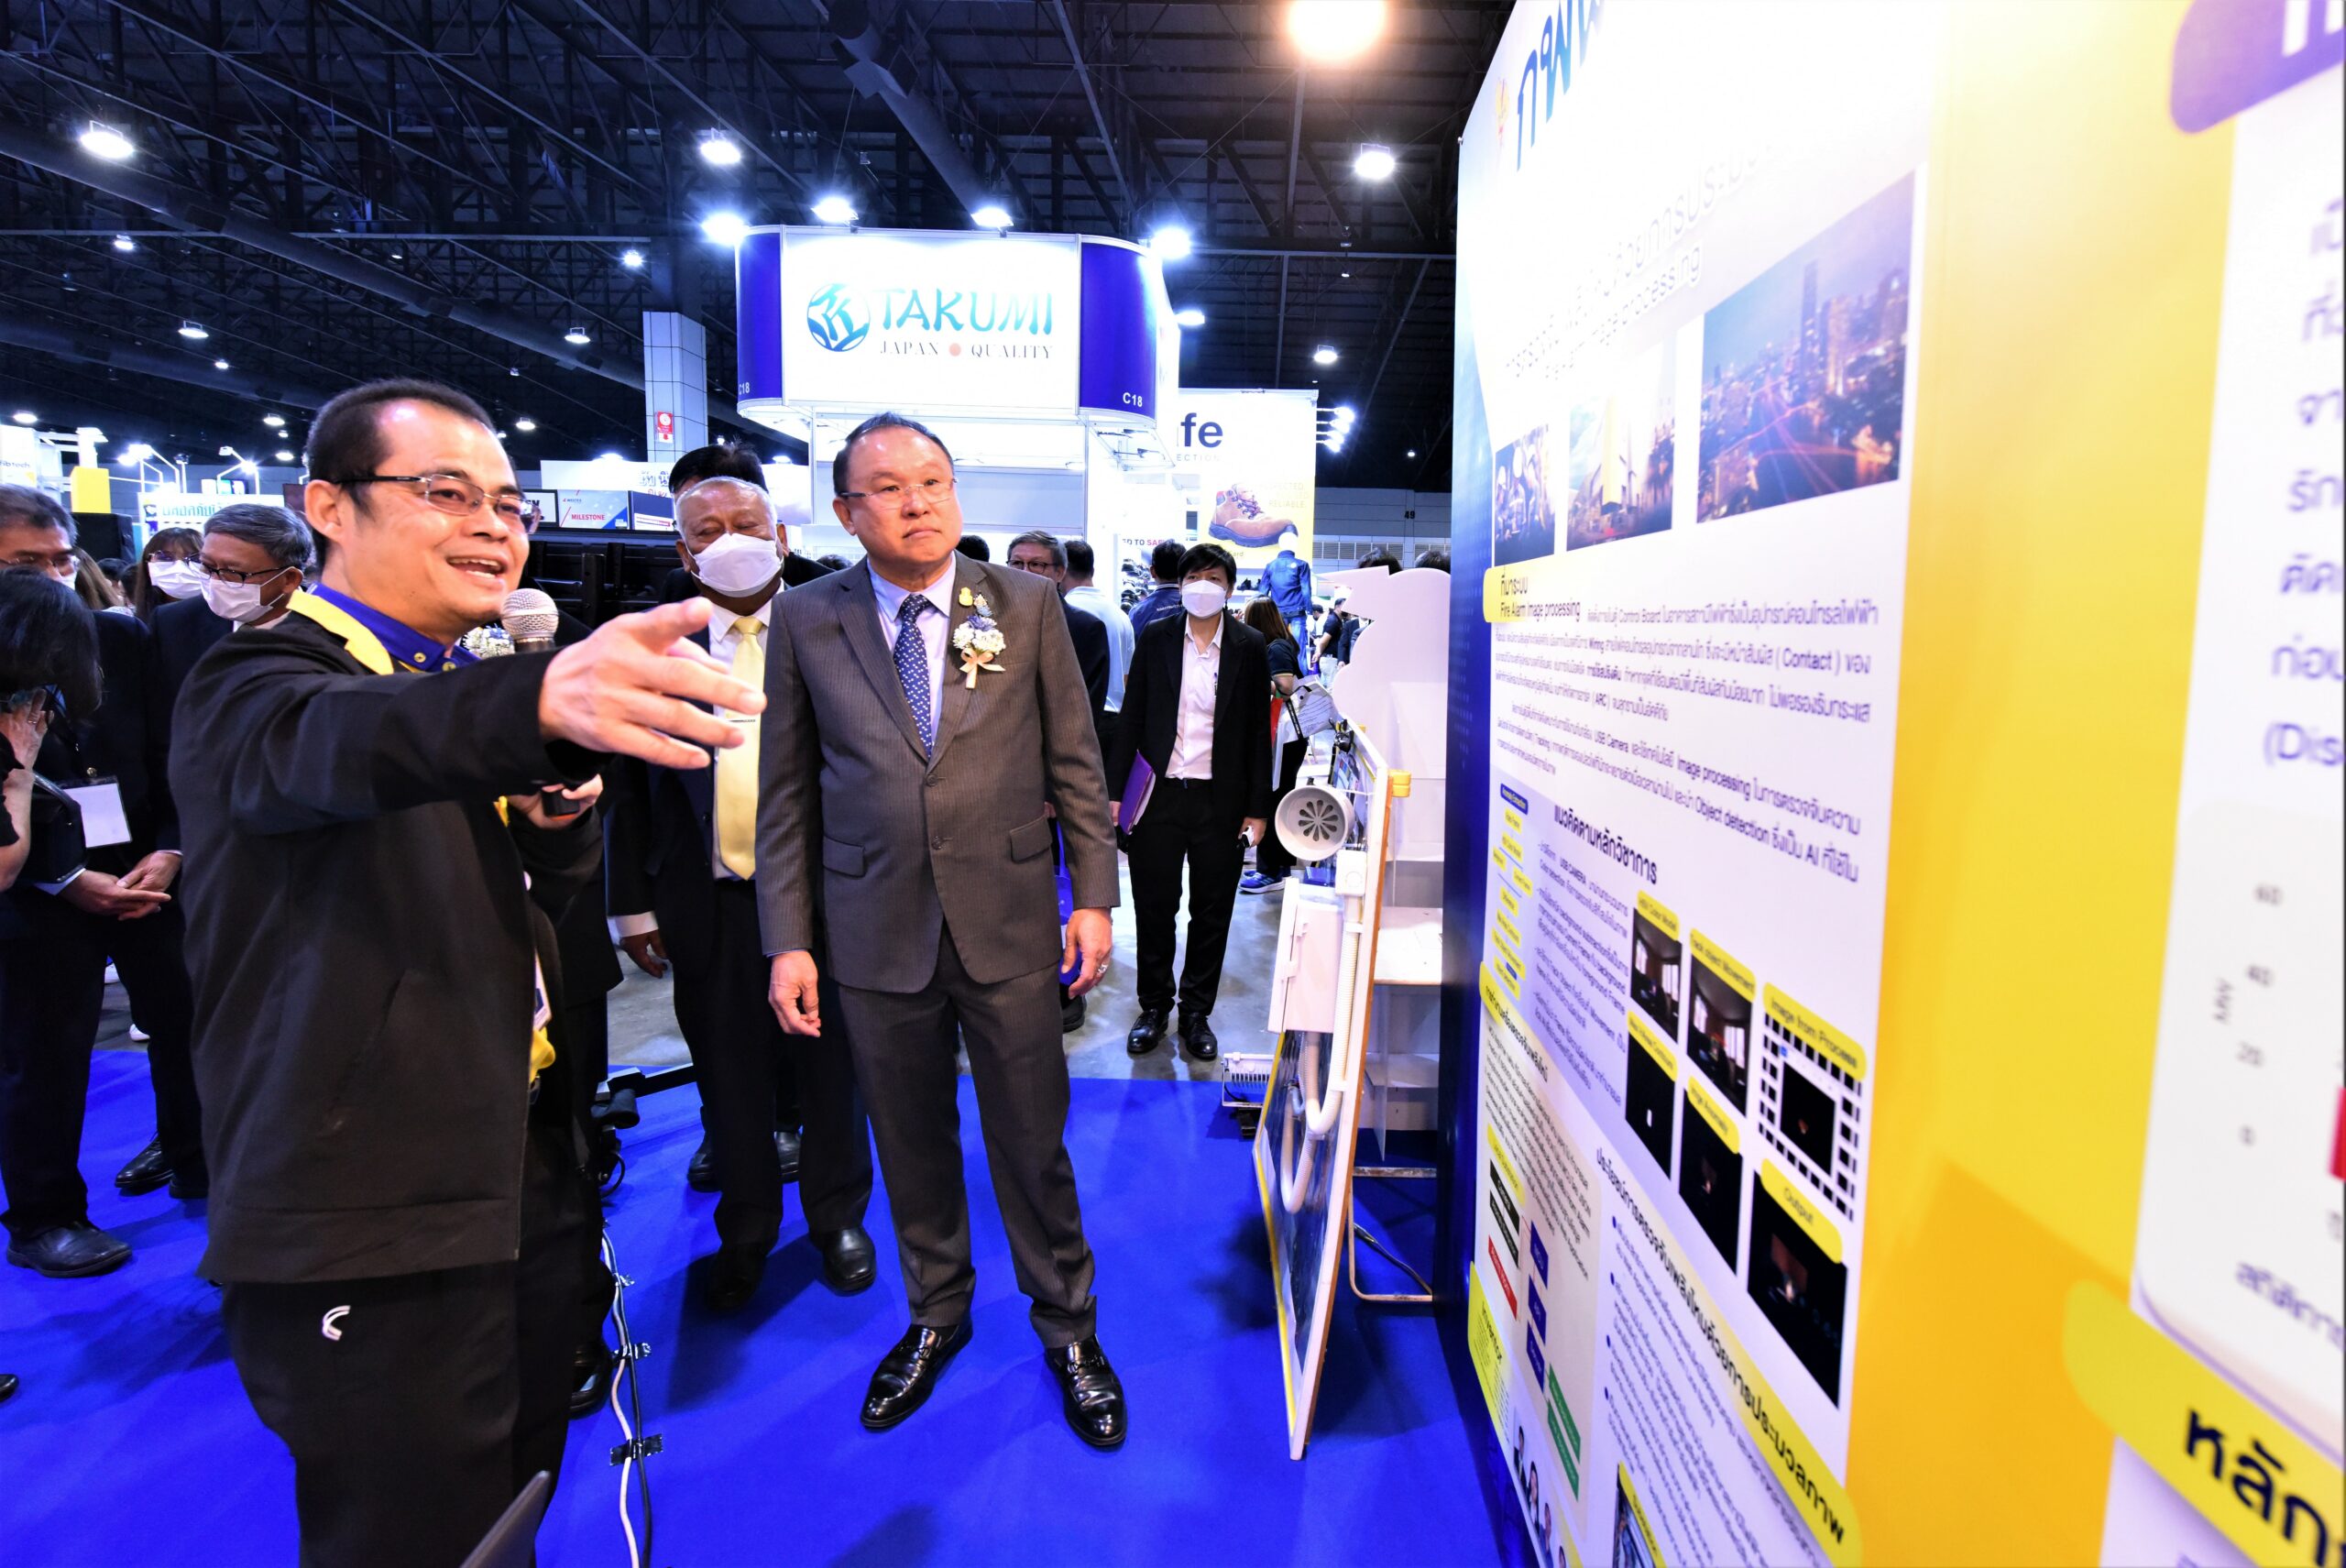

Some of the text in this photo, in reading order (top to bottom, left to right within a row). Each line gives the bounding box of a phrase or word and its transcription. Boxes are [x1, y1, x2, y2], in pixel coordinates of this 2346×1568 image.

[872, 288, 1053, 335] TAKUMI
[880, 340, 1053, 359] JAPAN QUALITY
[1123, 392, 1143, 408] C18
[1178, 412, 1223, 448] fe
[1500, 597, 1581, 622] Fire Alarm Image processing
[1702, 763, 1751, 804] processing
[1553, 796, 1658, 889] แนวคิดตามหลักวิชาการ
[1770, 993, 1799, 1032] Image
[1818, 1027, 1858, 1072] Process
[1782, 1180, 1814, 1231] Output
[2185, 1408, 2344, 1568] หลัก
